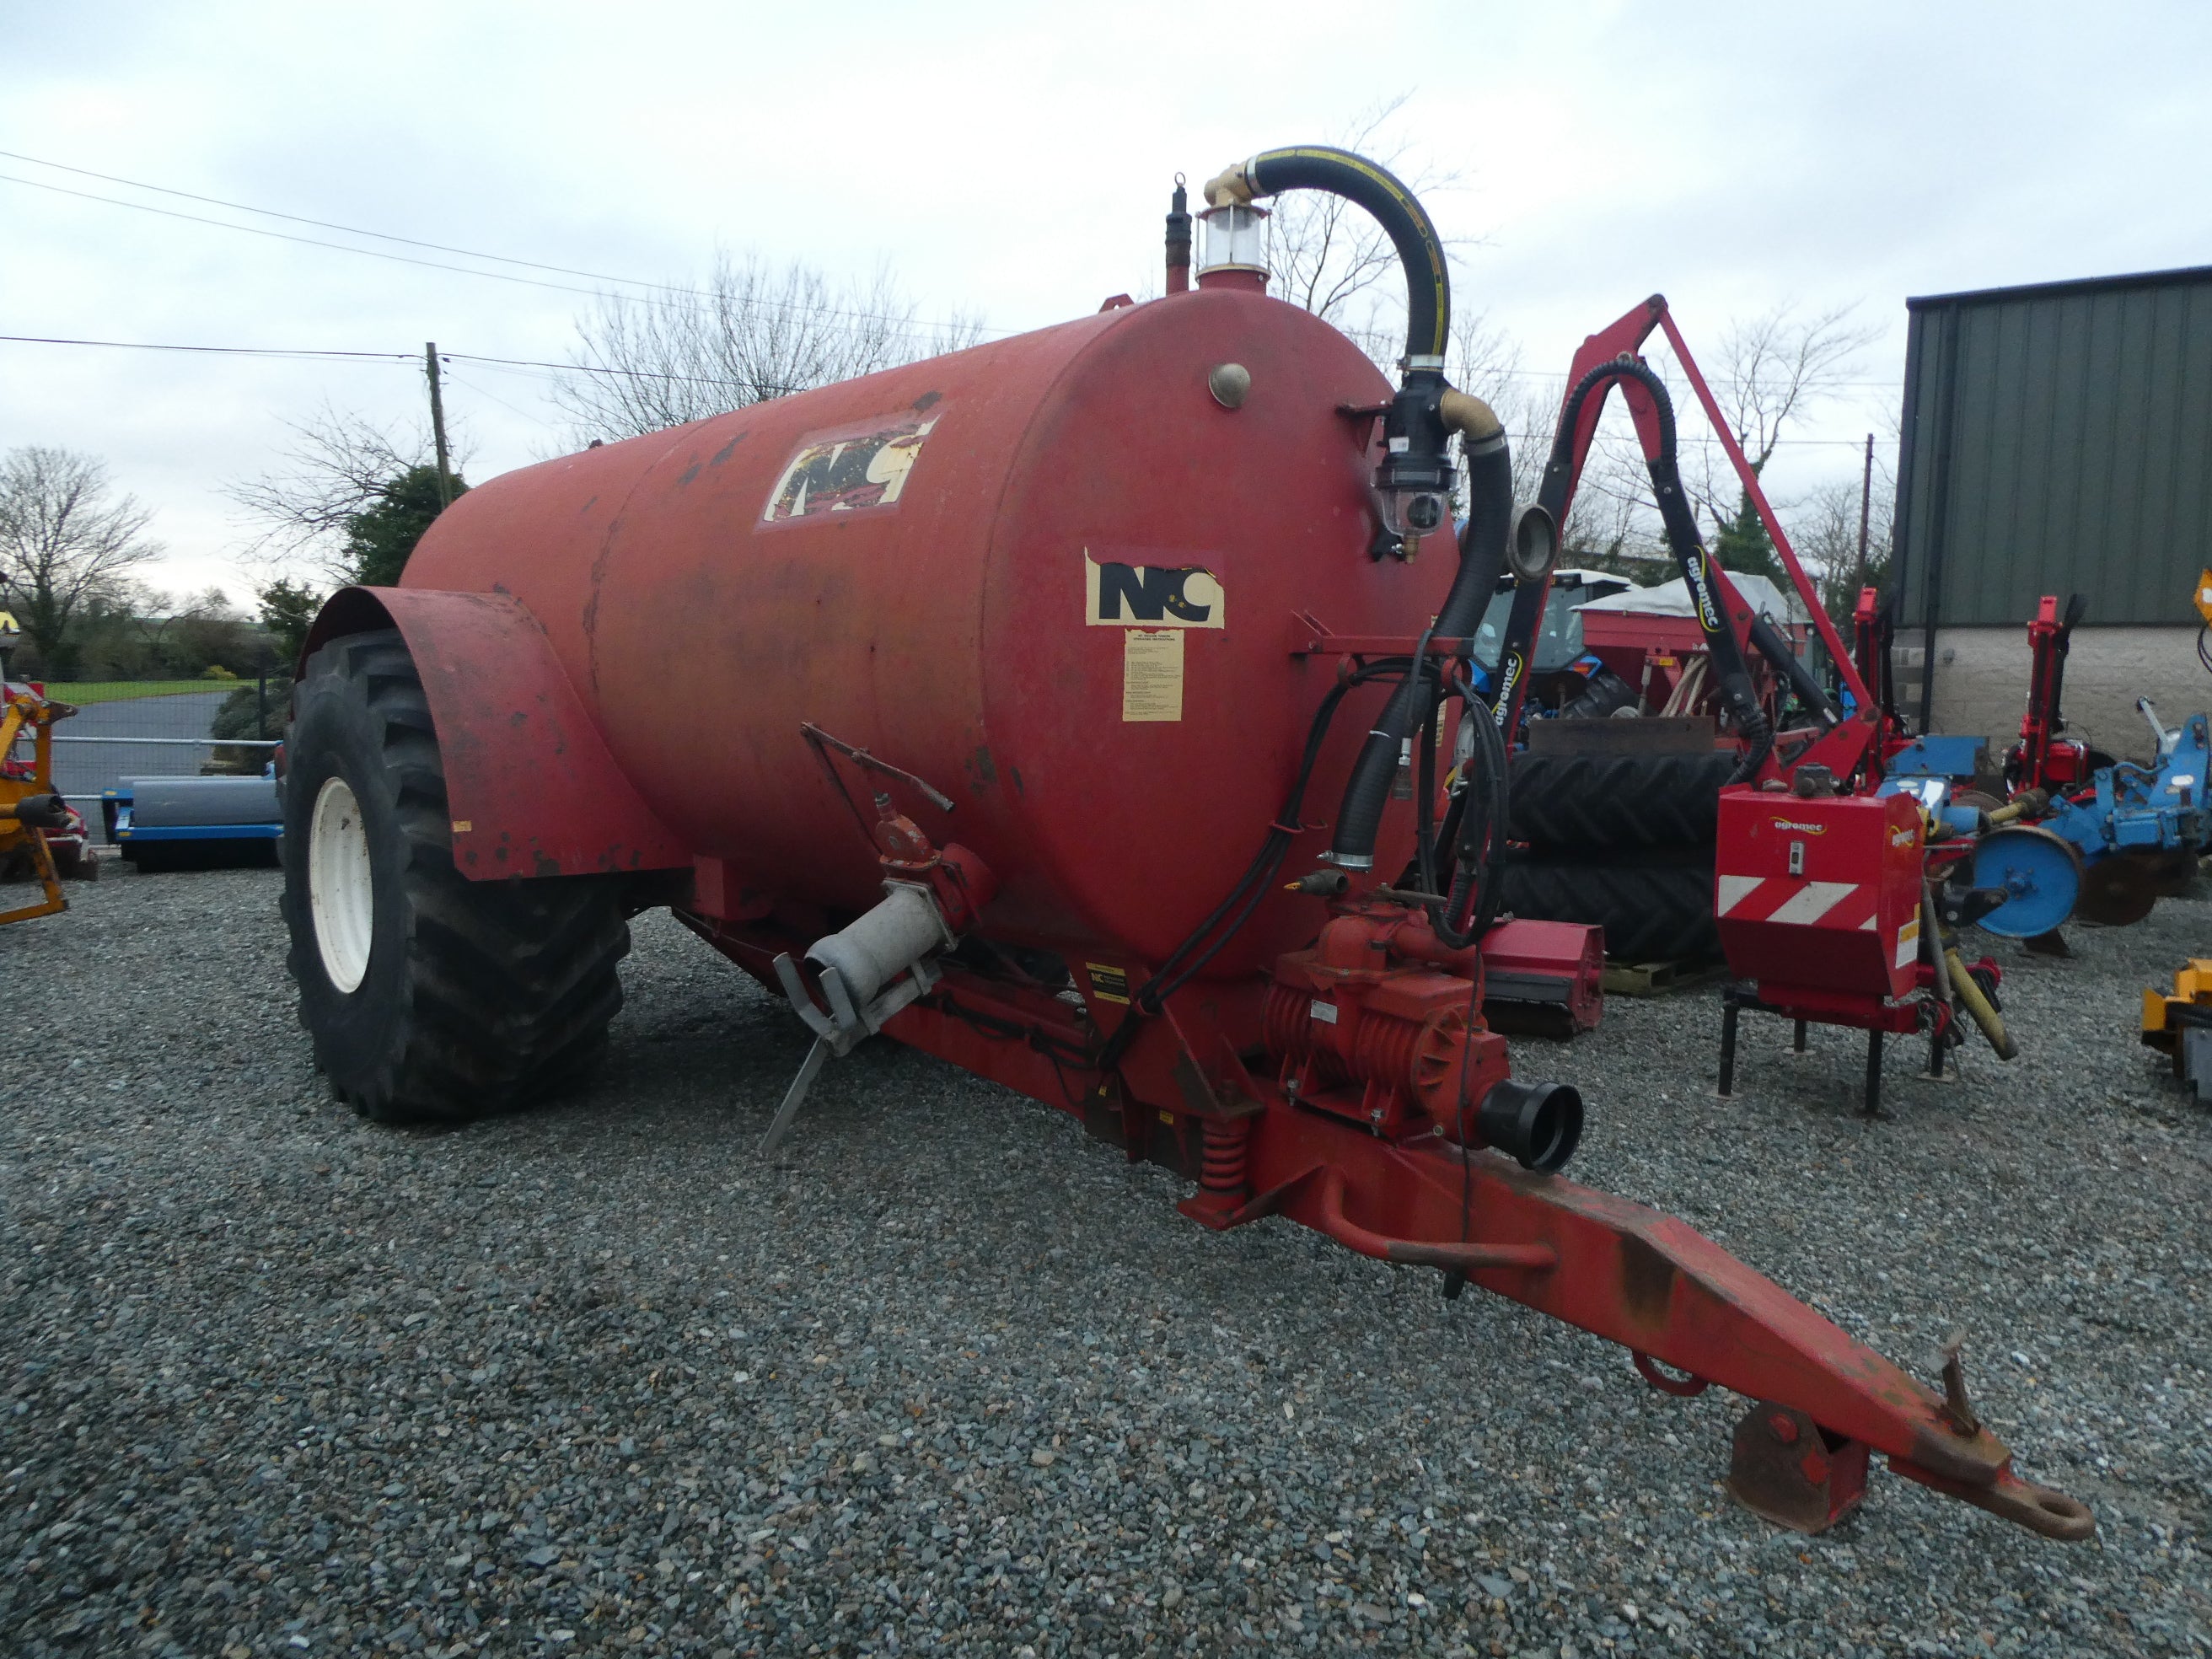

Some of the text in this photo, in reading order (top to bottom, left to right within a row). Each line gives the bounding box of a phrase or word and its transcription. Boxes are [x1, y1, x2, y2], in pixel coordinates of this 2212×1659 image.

[1098, 561, 1211, 622] NC
[1687, 556, 1719, 627] agromec
[1495, 658, 1517, 727] agromec
[1774, 821, 1823, 831] agromec
